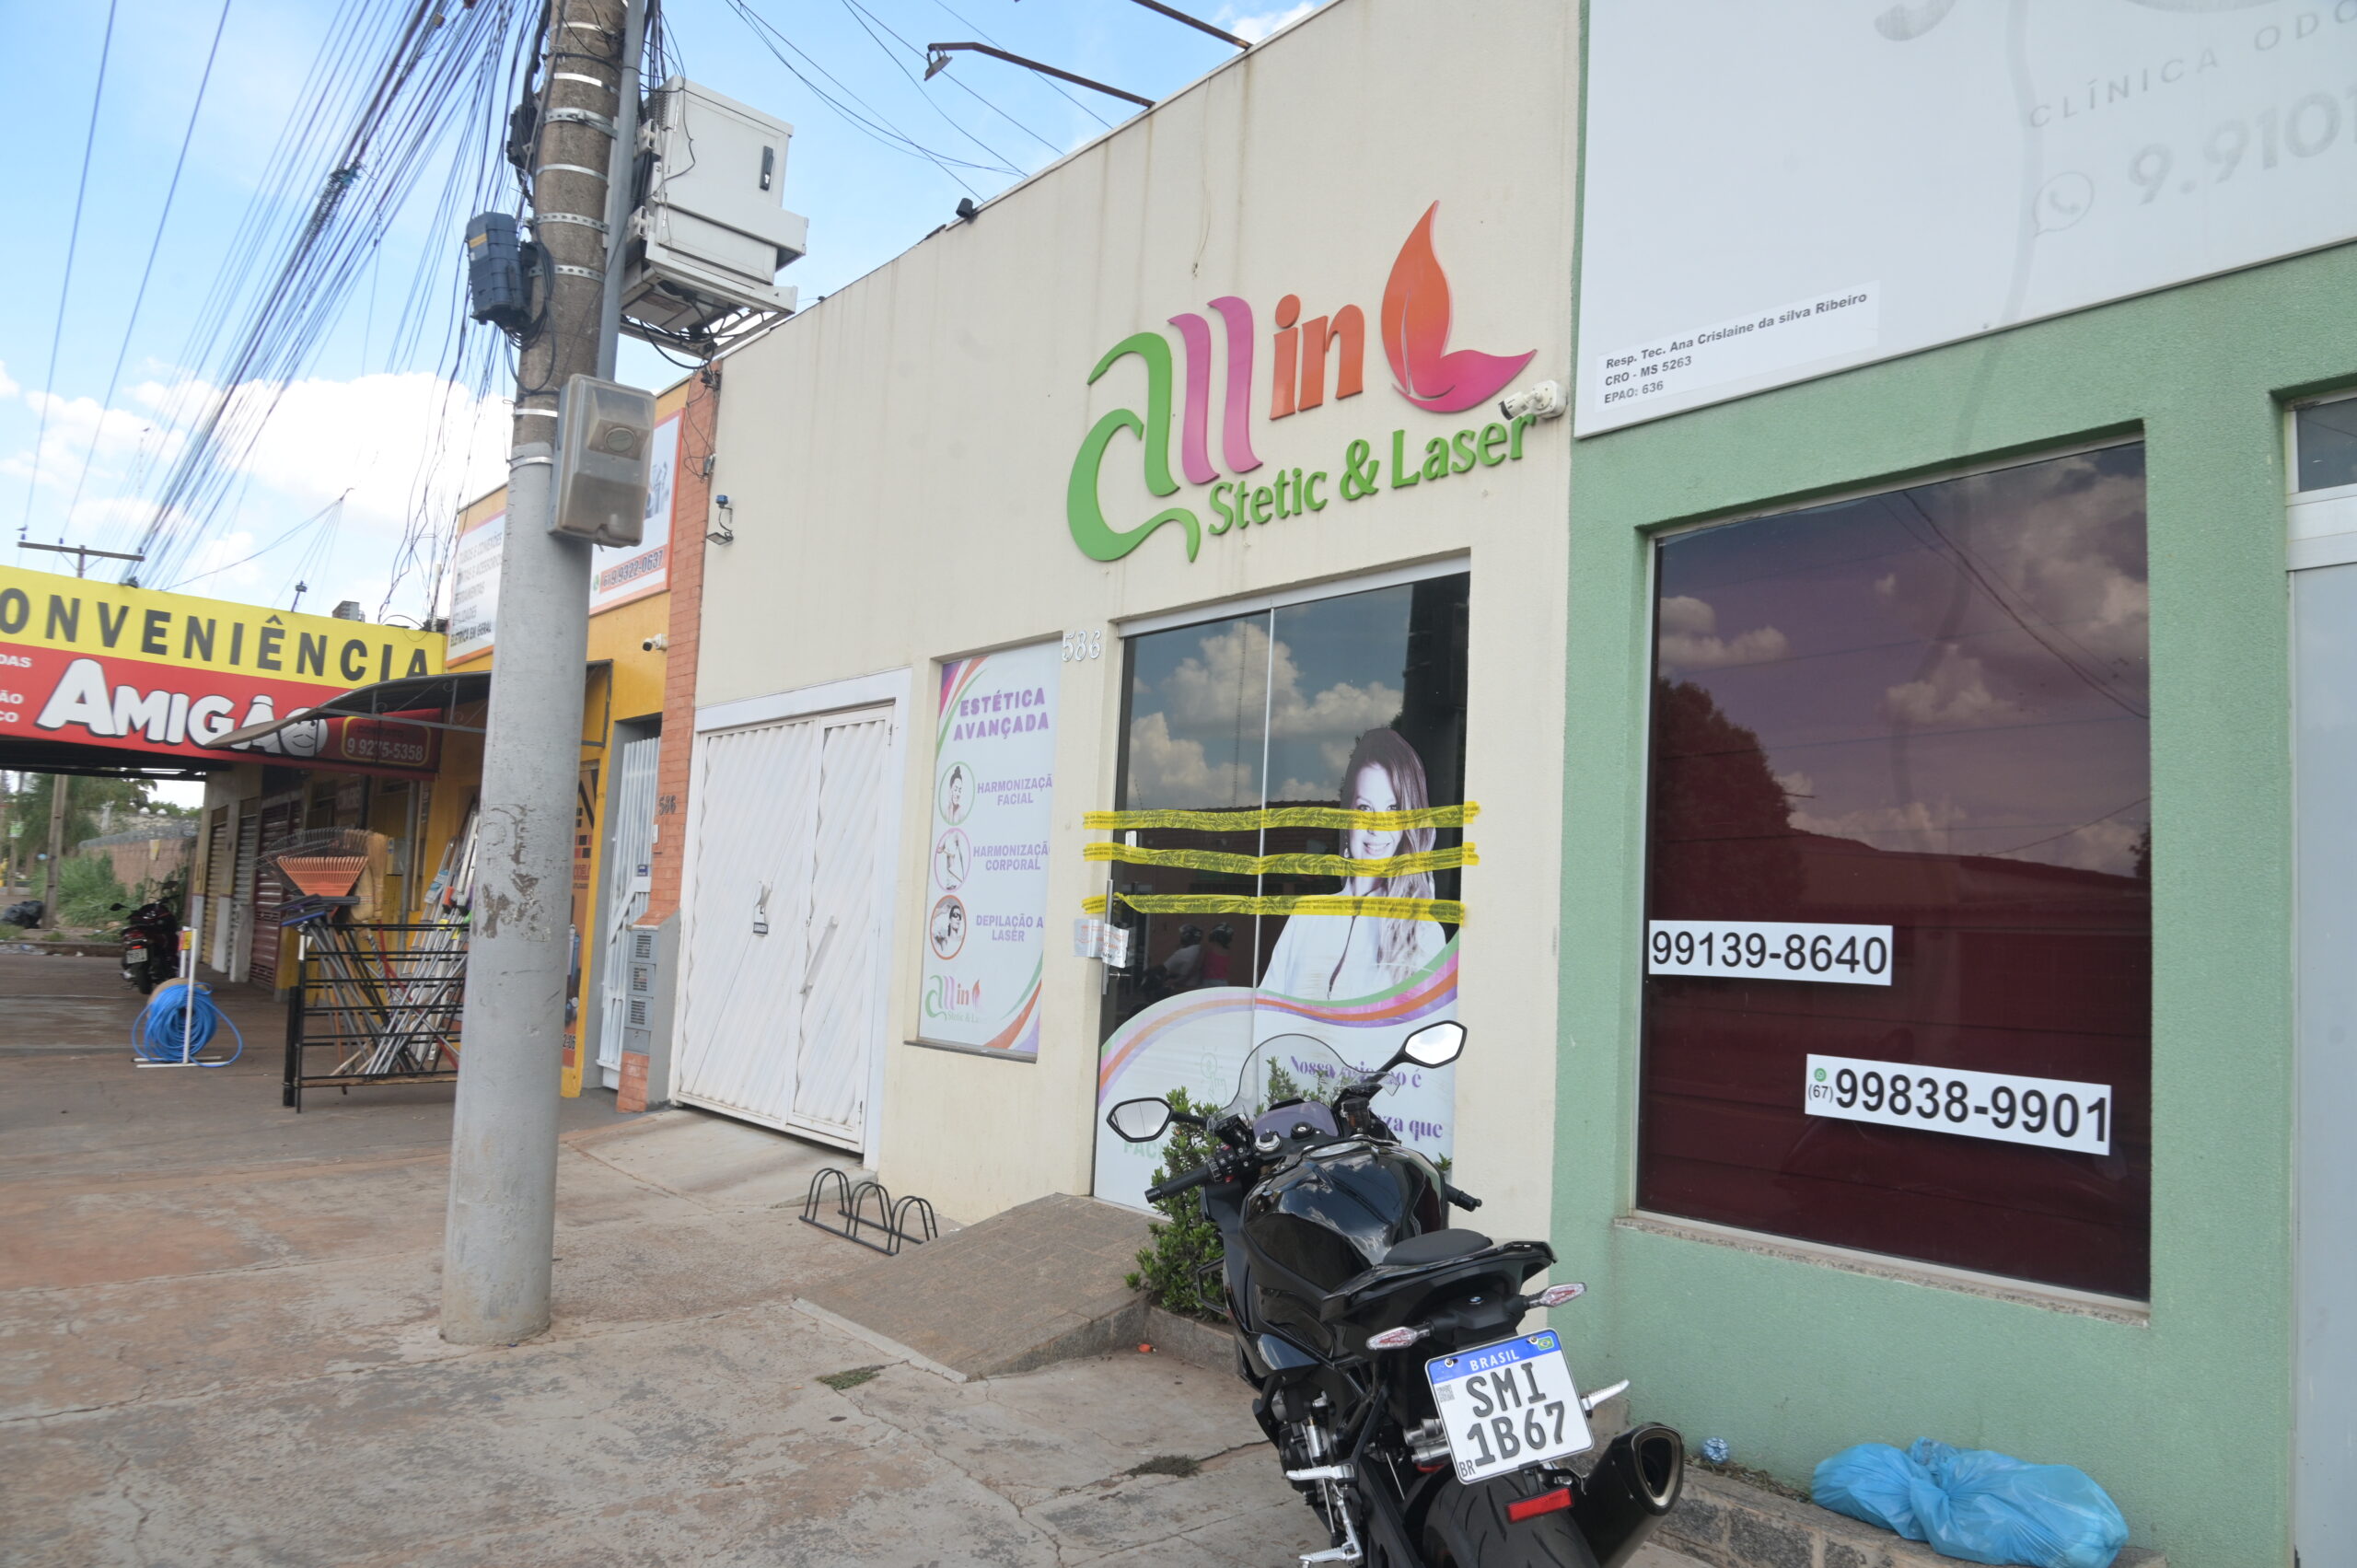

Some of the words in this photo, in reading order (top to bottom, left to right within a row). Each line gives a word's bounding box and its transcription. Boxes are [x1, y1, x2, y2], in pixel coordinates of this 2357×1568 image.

[2028, 49, 2220, 128] CLÍNICA
[1606, 355, 1637, 370] Resp.
[1641, 346, 1666, 360] Tec.
[1669, 339, 1693, 353] Ana
[1697, 322, 1754, 346] Crislaine
[1758, 317, 1774, 330] da
[1778, 307, 1811, 324] silva
[1815, 293, 1867, 314] Ribeiro
[1605, 370, 1630, 387] CRO
[1640, 365, 1658, 378] MS
[1662, 355, 1692, 372] 5263
[1604, 387, 1639, 404] EPAO:
[1642, 380, 1664, 395] 636
[1206, 466, 1329, 536] Stetic
[1339, 438, 1379, 502] &
[1390, 412, 1537, 490] Laser
[1062, 630, 1101, 662] 586
[959, 688, 1045, 717] ESTÉTICA
[953, 712, 1049, 740] AVANÇADA
[997, 794, 1034, 807] FACIAL
[972, 841, 1051, 858] HARMONIZAÇÃ
[985, 858, 1040, 871] CORPORAL
[976, 912, 1032, 928] DEPILAÇÃO
[1036, 915, 1044, 928] A
[992, 928, 1025, 942] LASER
[1653, 931, 1887, 974] 99139-8640
[1807, 1084, 1834, 1103] (67)
[1835, 1068, 2107, 1143] 99838-9901
[1409, 1119, 1444, 1142] que
[1469, 1349, 1520, 1372] BRASIL
[1466, 1362, 1547, 1418] SMI
[1467, 1400, 1565, 1467] 1B67
[1458, 1459, 1476, 1478] BR
